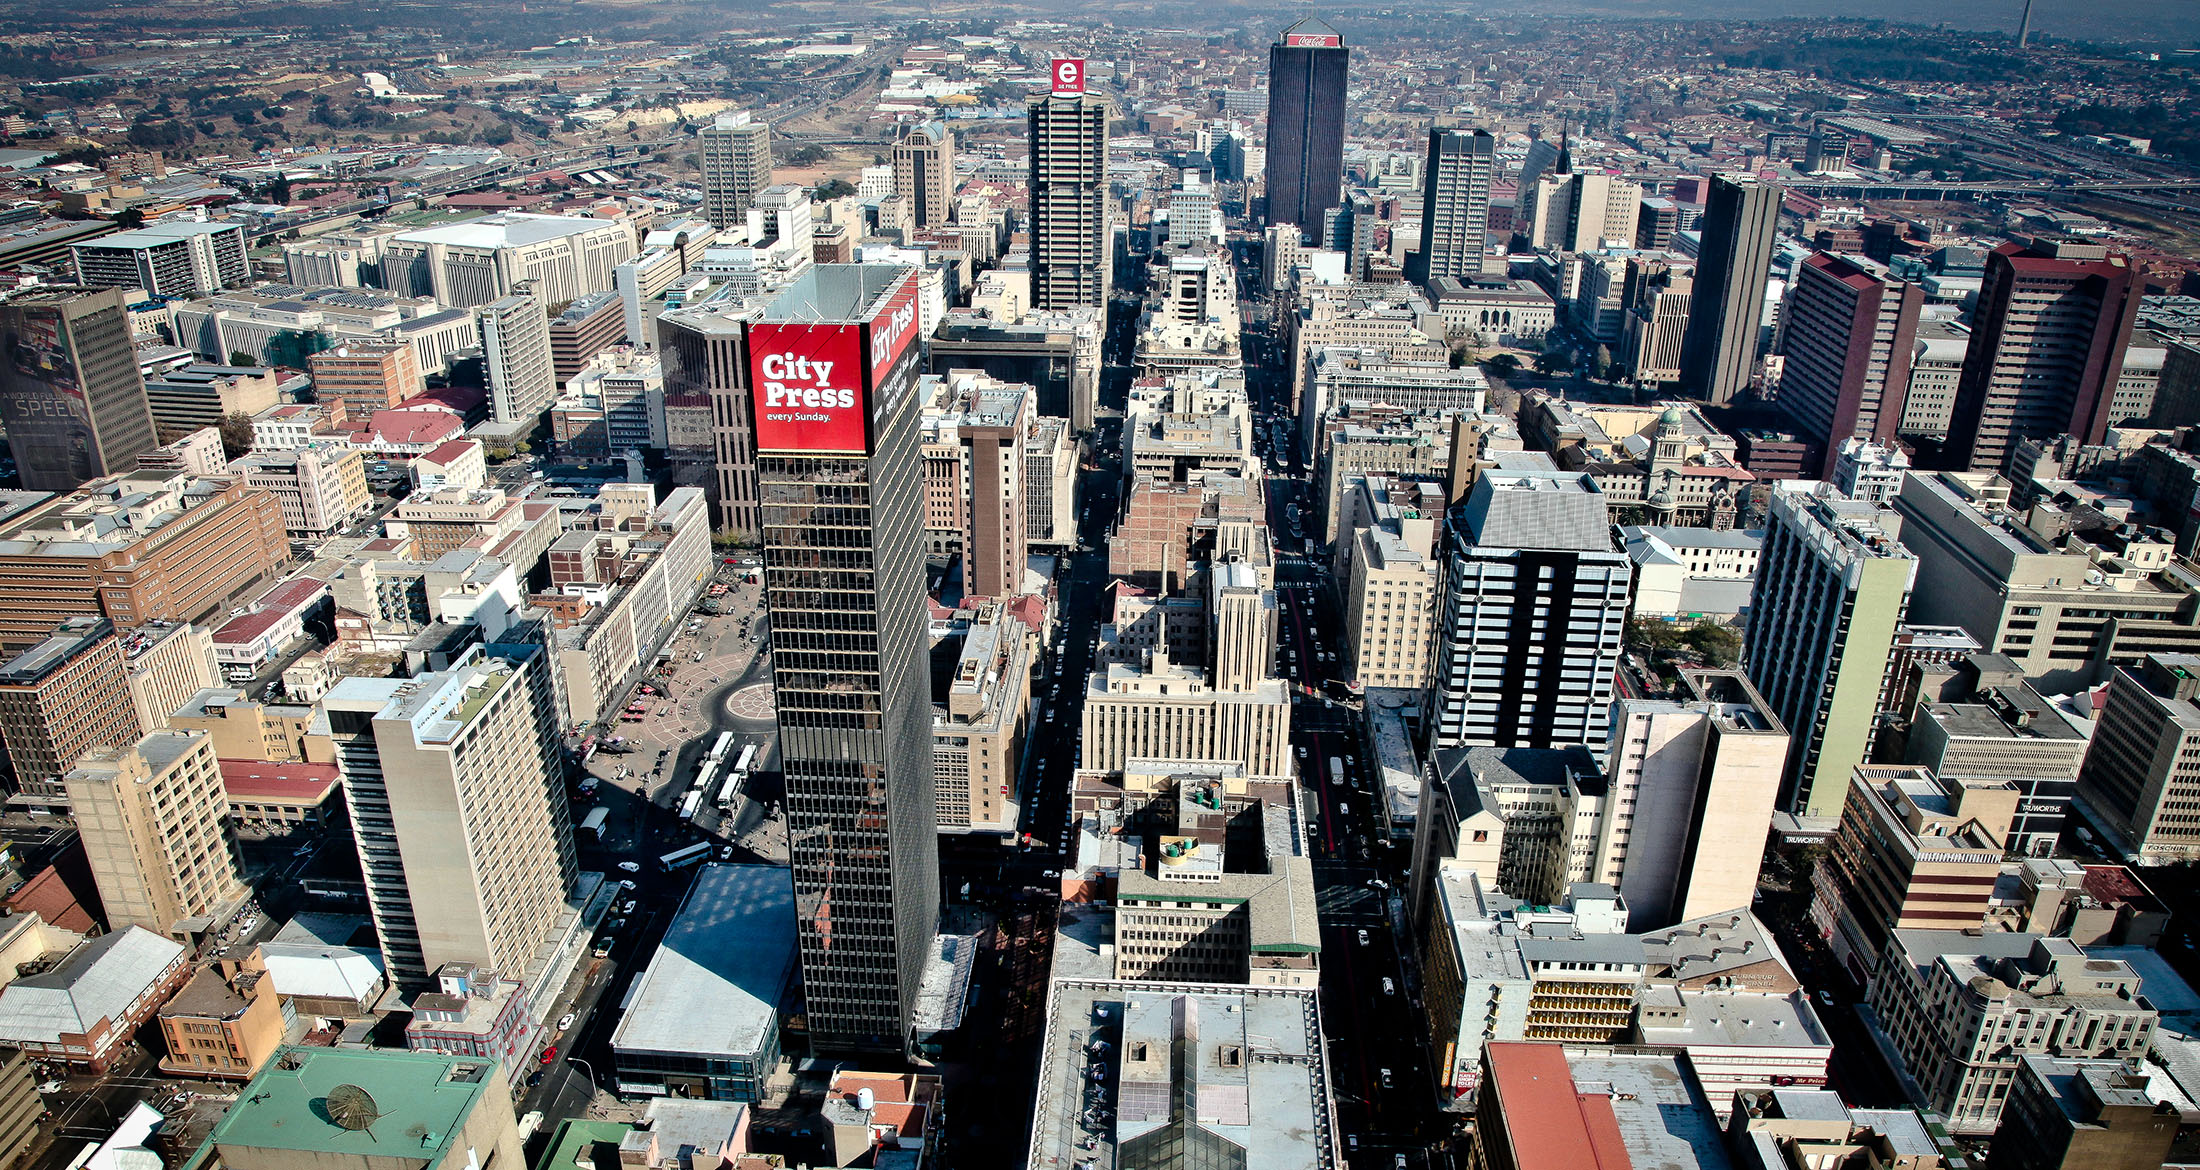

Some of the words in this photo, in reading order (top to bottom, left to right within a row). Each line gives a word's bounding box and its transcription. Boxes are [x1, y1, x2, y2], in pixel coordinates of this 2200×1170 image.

[1058, 62, 1078, 83] e
[872, 324, 891, 370] City
[762, 351, 834, 387] City
[10, 392, 39, 400] WORLD
[763, 381, 855, 408] Press
[767, 413, 793, 423] every
[794, 412, 831, 423] Sunday.
[2022, 804, 2061, 812] TRUWORTHS
[1785, 836, 1825, 844] TRUWORTHS
